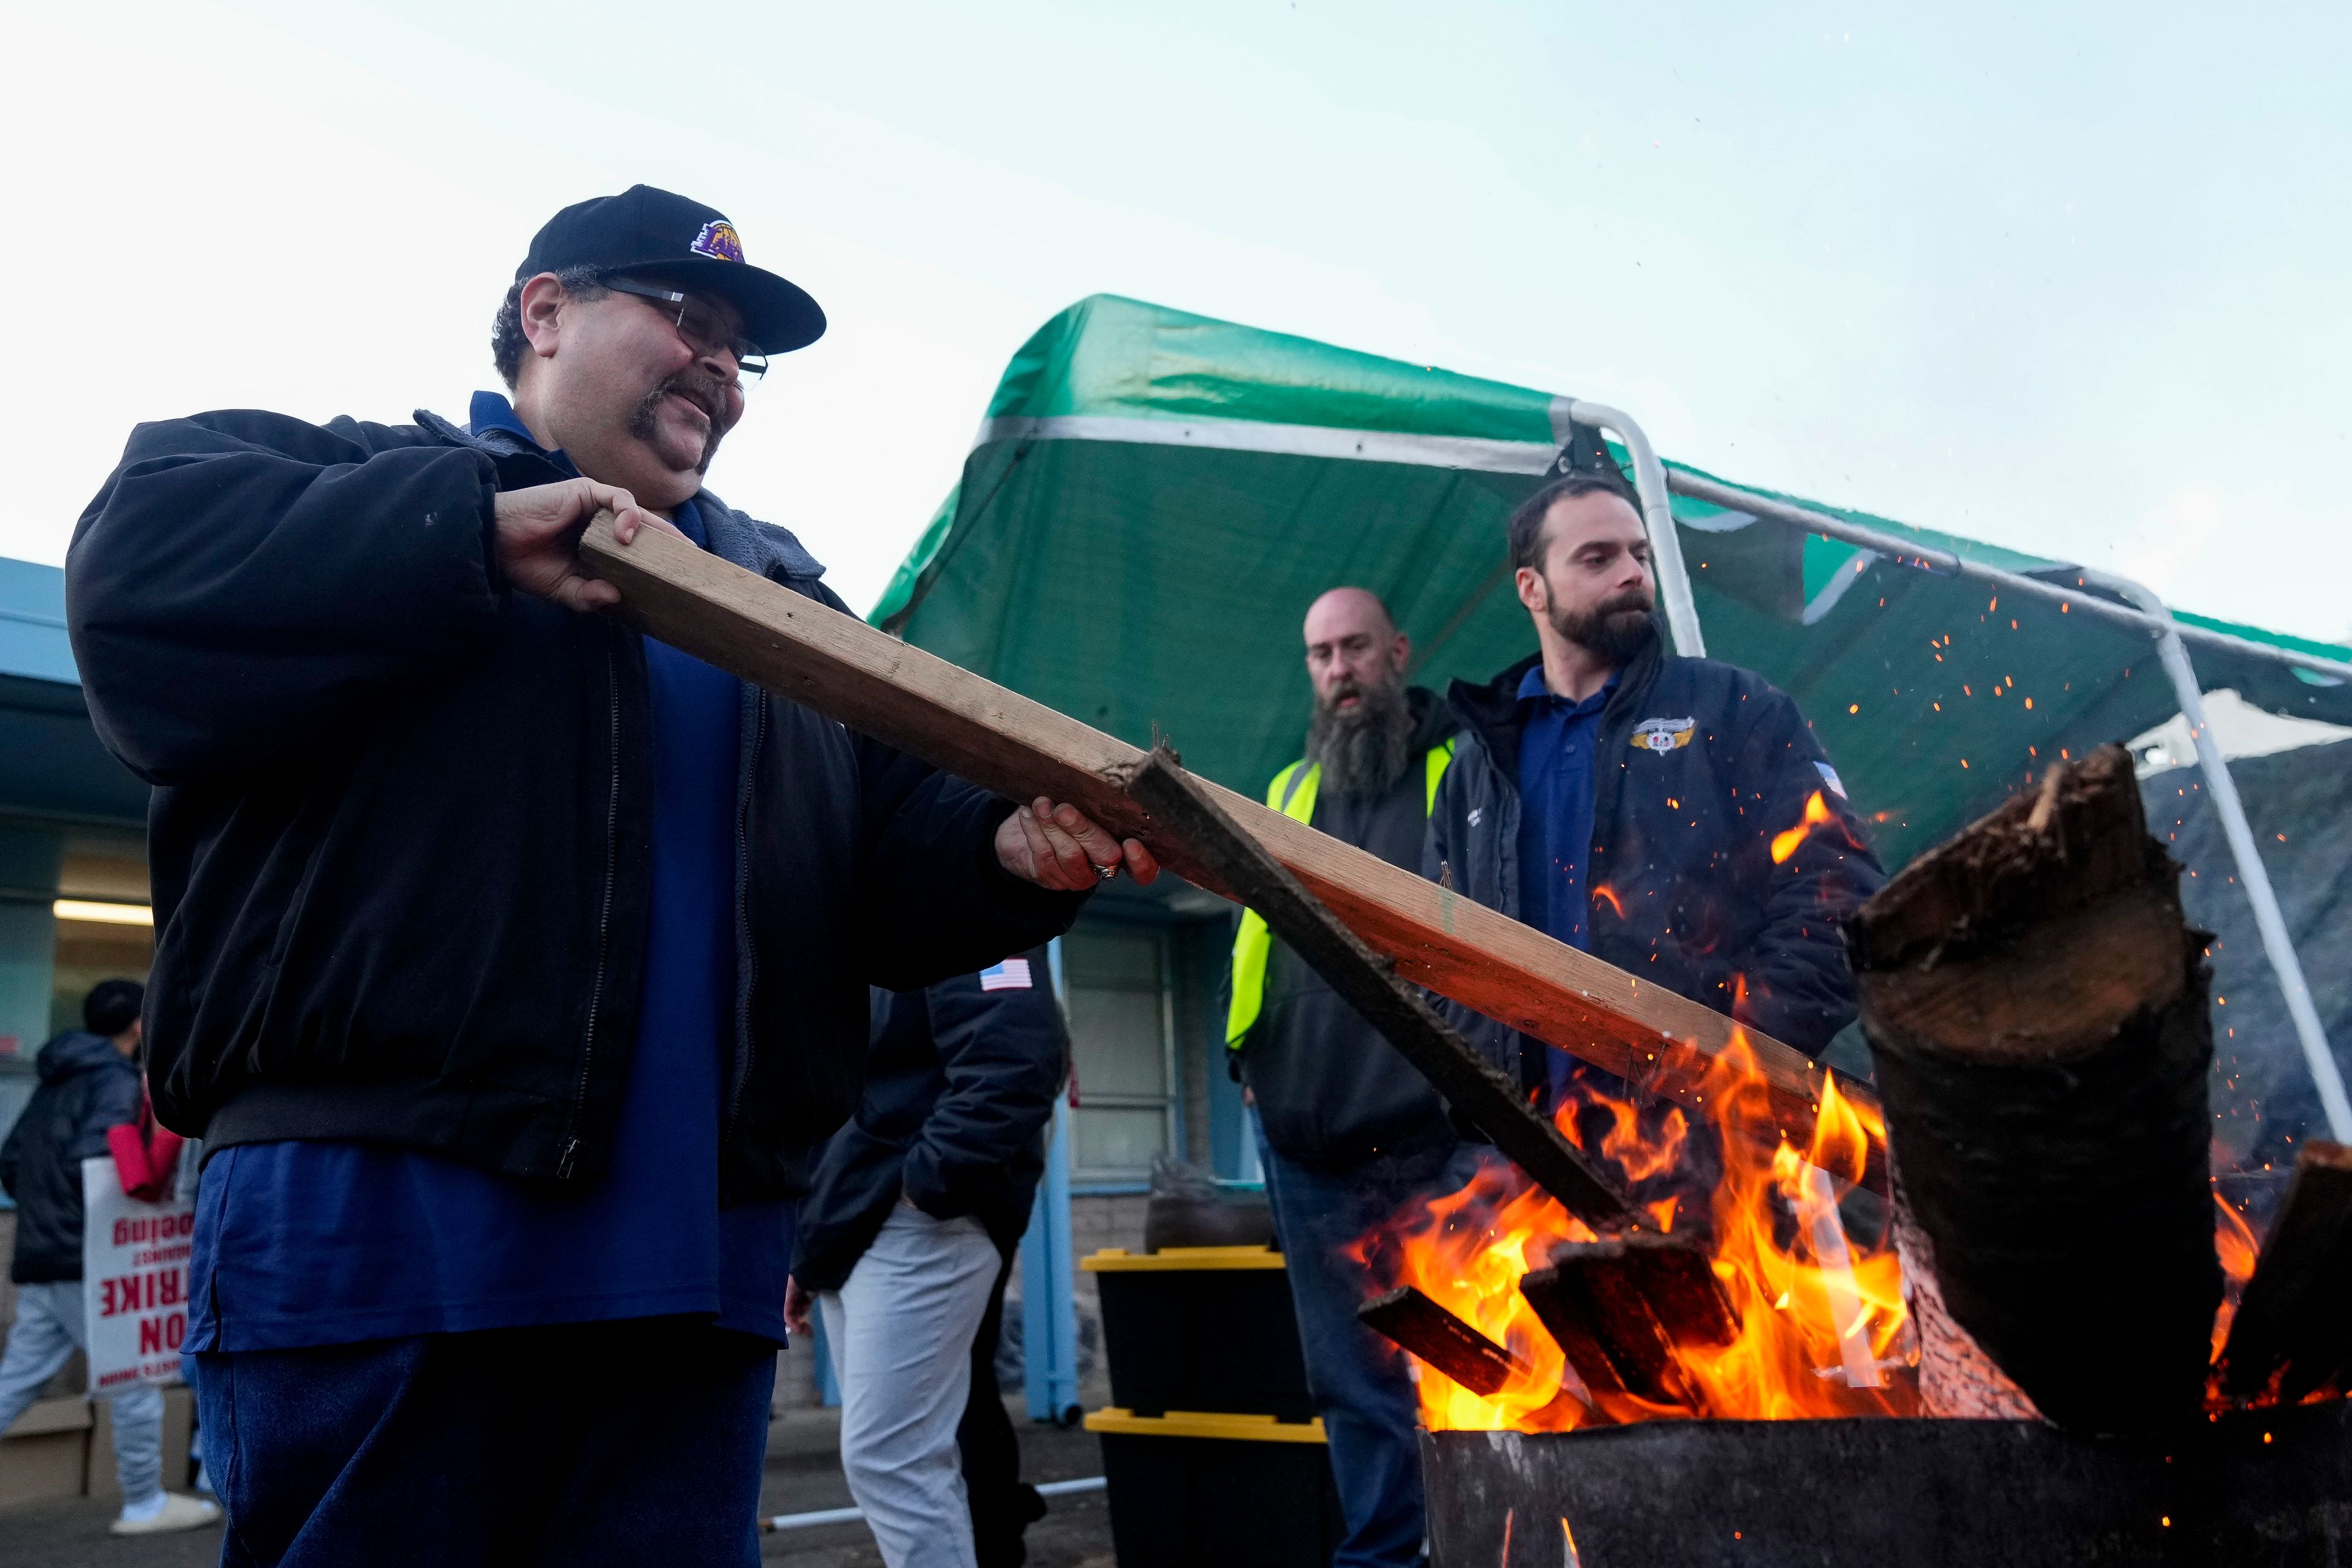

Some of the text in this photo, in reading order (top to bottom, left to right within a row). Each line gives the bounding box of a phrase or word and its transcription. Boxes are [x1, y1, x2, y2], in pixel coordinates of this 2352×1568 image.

[114, 1214, 194, 1246] oeing
[101, 1268, 189, 1316] RIKE
[140, 1314, 185, 1355] ON
